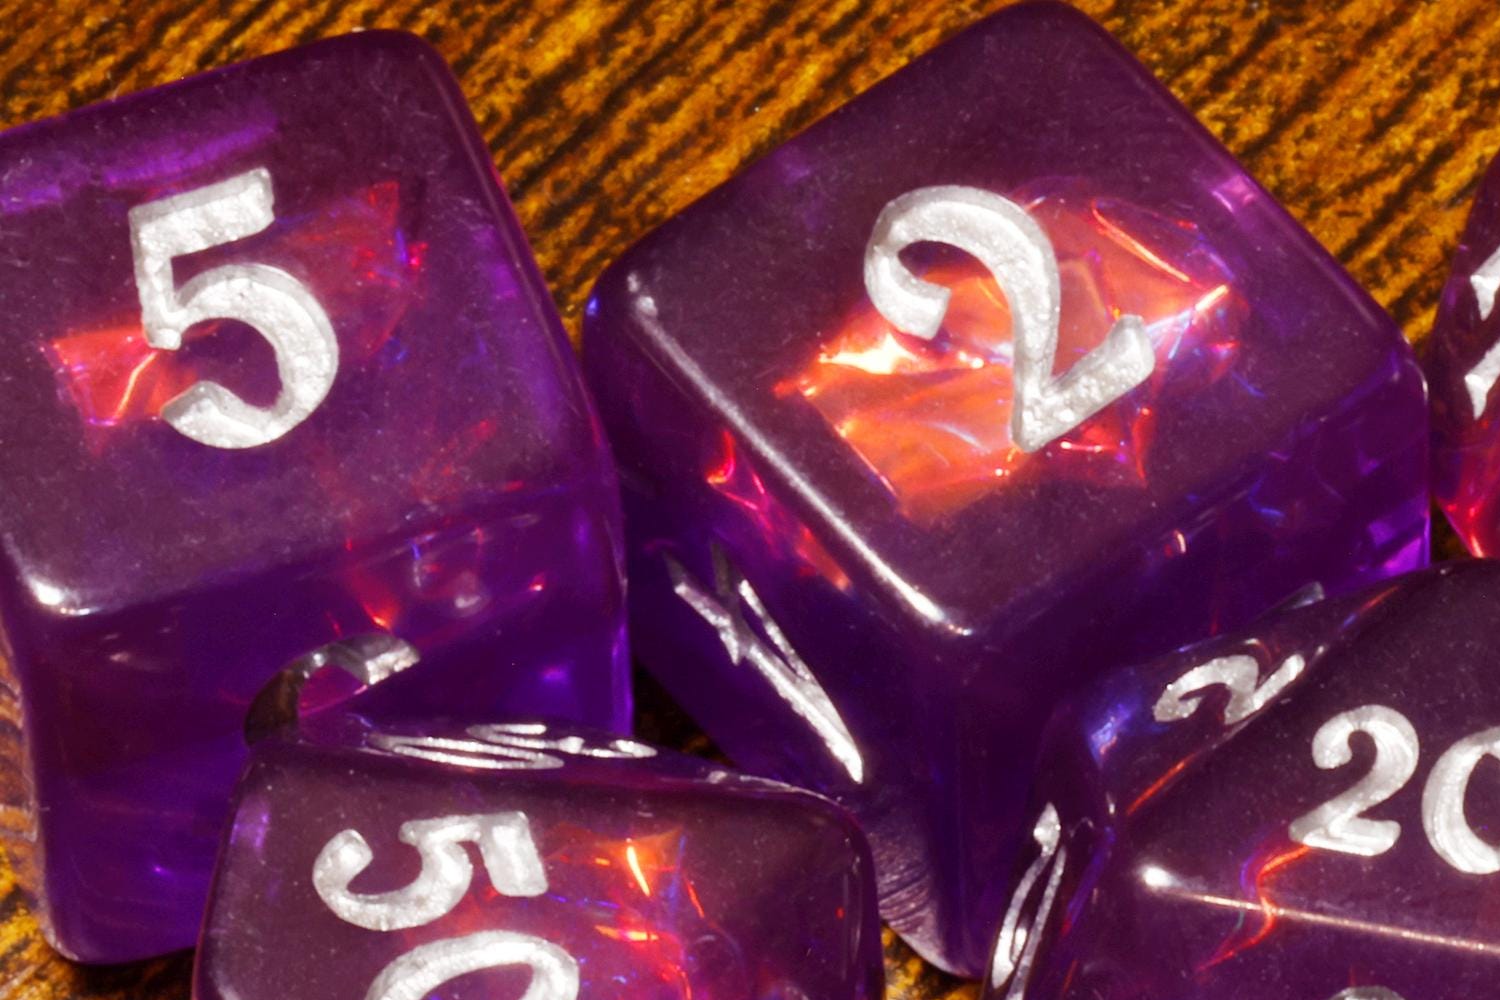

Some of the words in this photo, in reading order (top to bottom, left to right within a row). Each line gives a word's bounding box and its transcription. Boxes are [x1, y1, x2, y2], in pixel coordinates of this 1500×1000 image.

[129, 167, 340, 450] 5
[864, 184, 1155, 454] 2
[1152, 653, 1305, 726] 2
